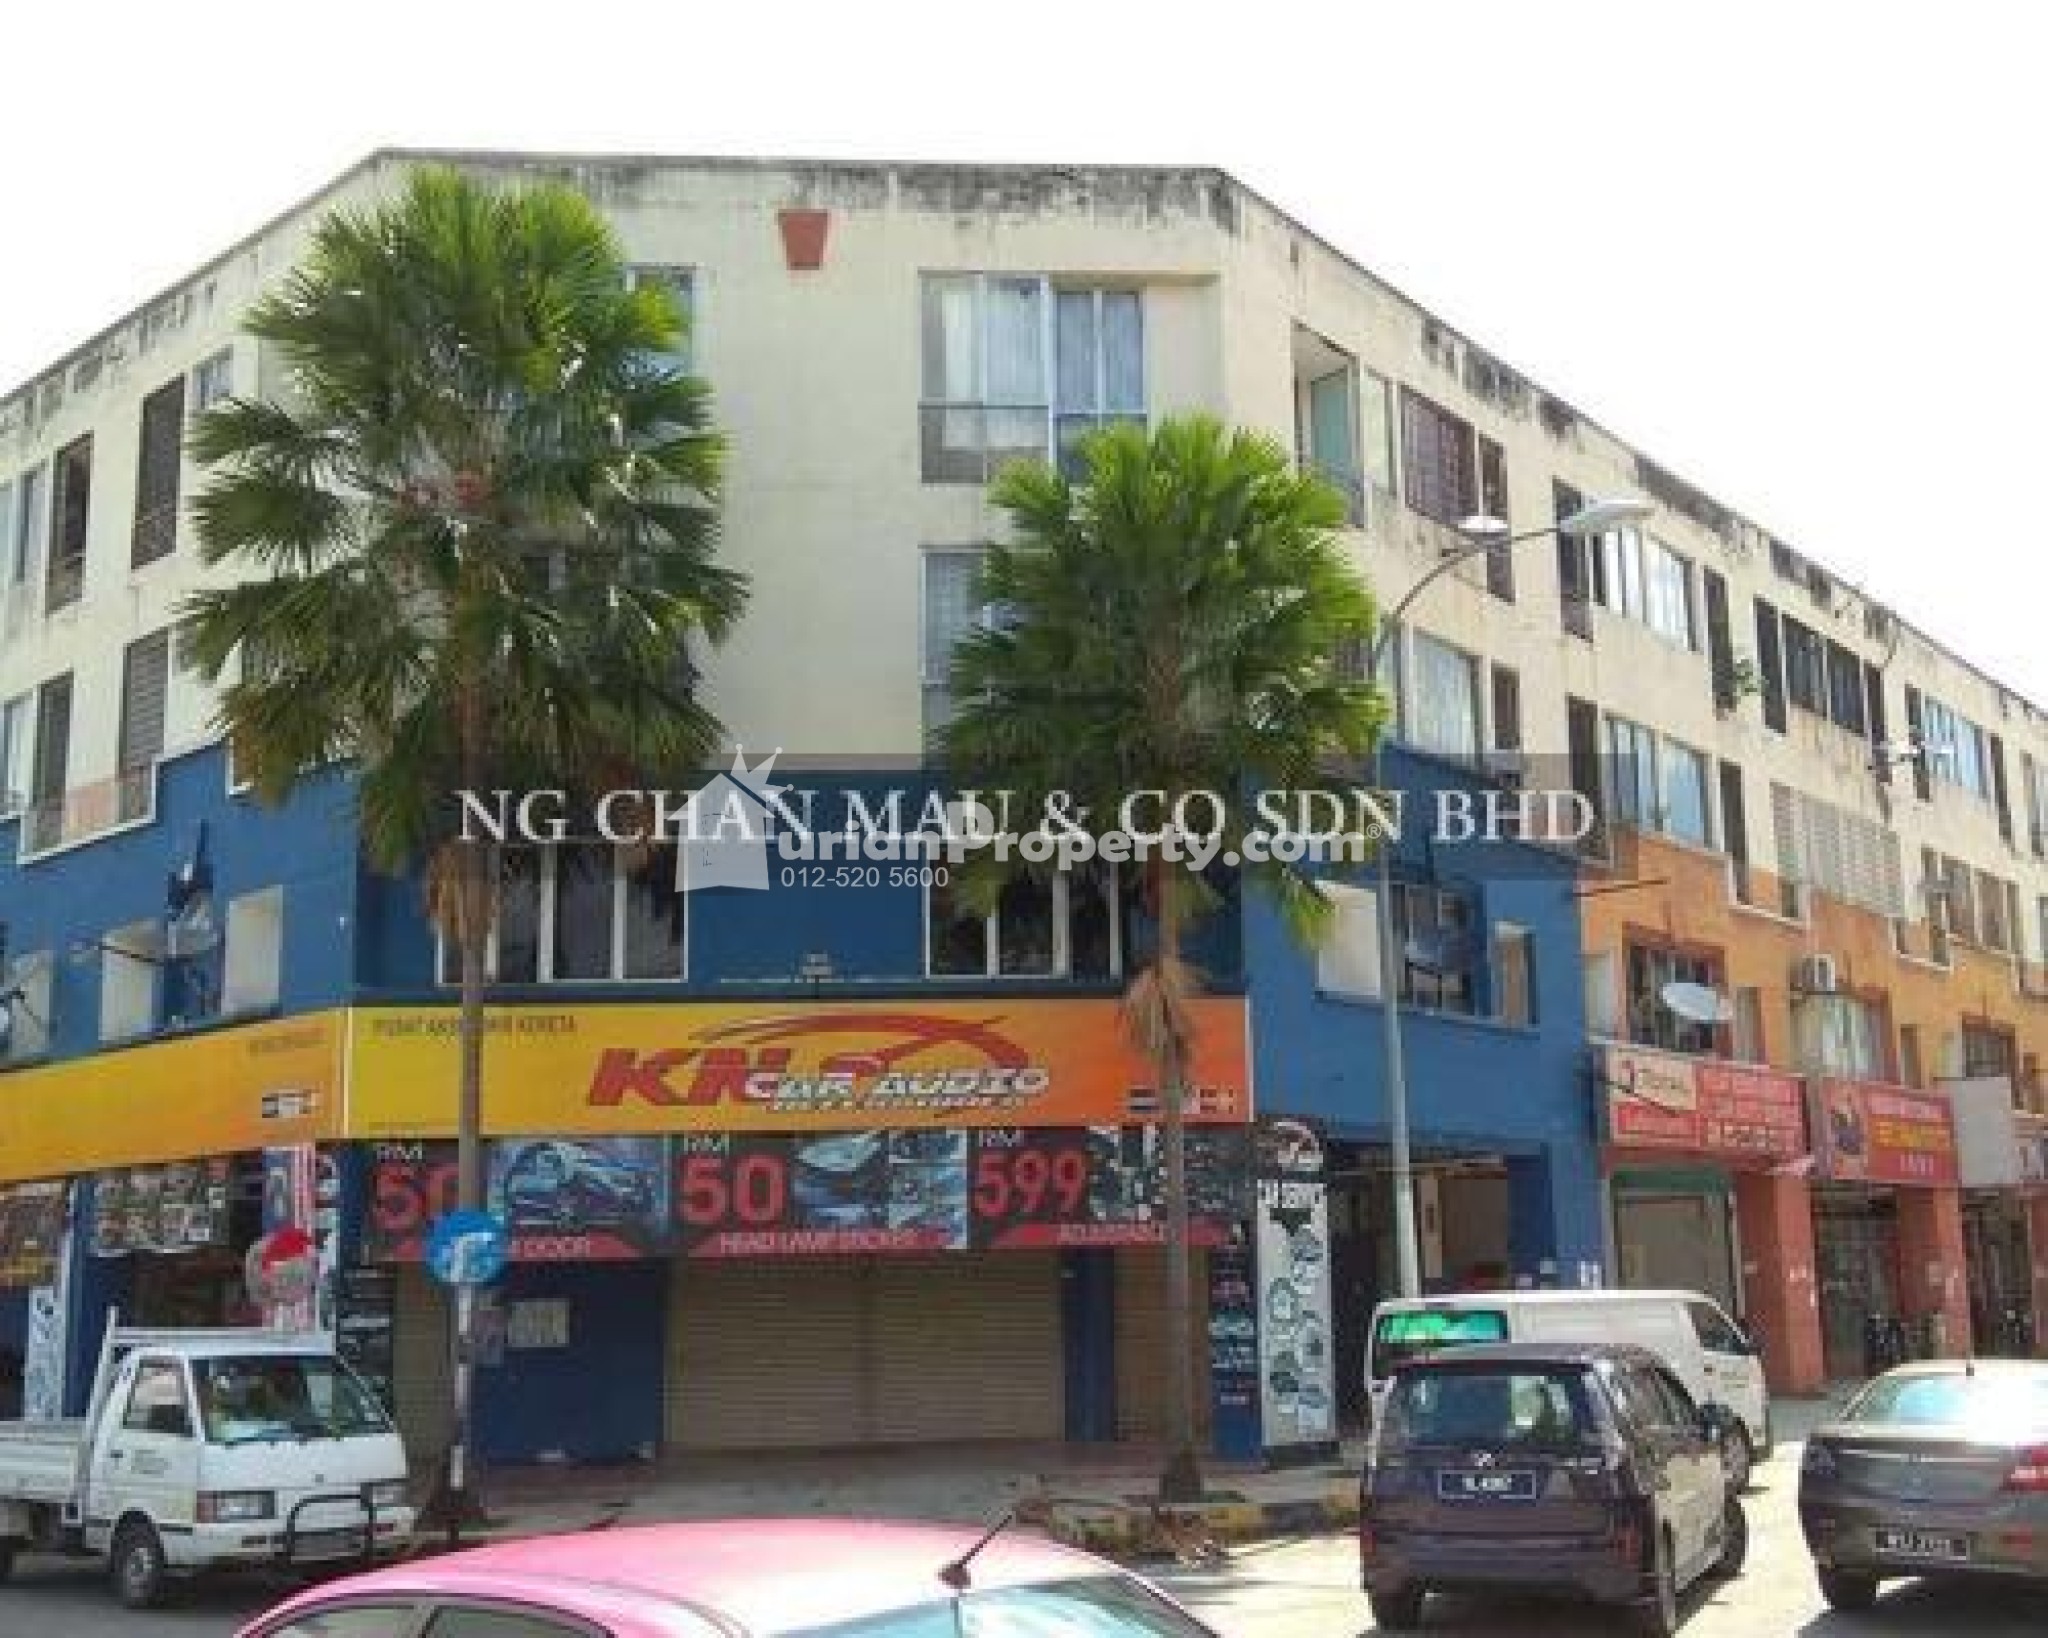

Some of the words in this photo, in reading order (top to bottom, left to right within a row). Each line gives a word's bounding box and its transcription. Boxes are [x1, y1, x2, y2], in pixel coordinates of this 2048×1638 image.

[873, 1068, 1051, 1097] AUDIO
[679, 1153, 785, 1227] 50
[975, 1149, 1088, 1217] 599
